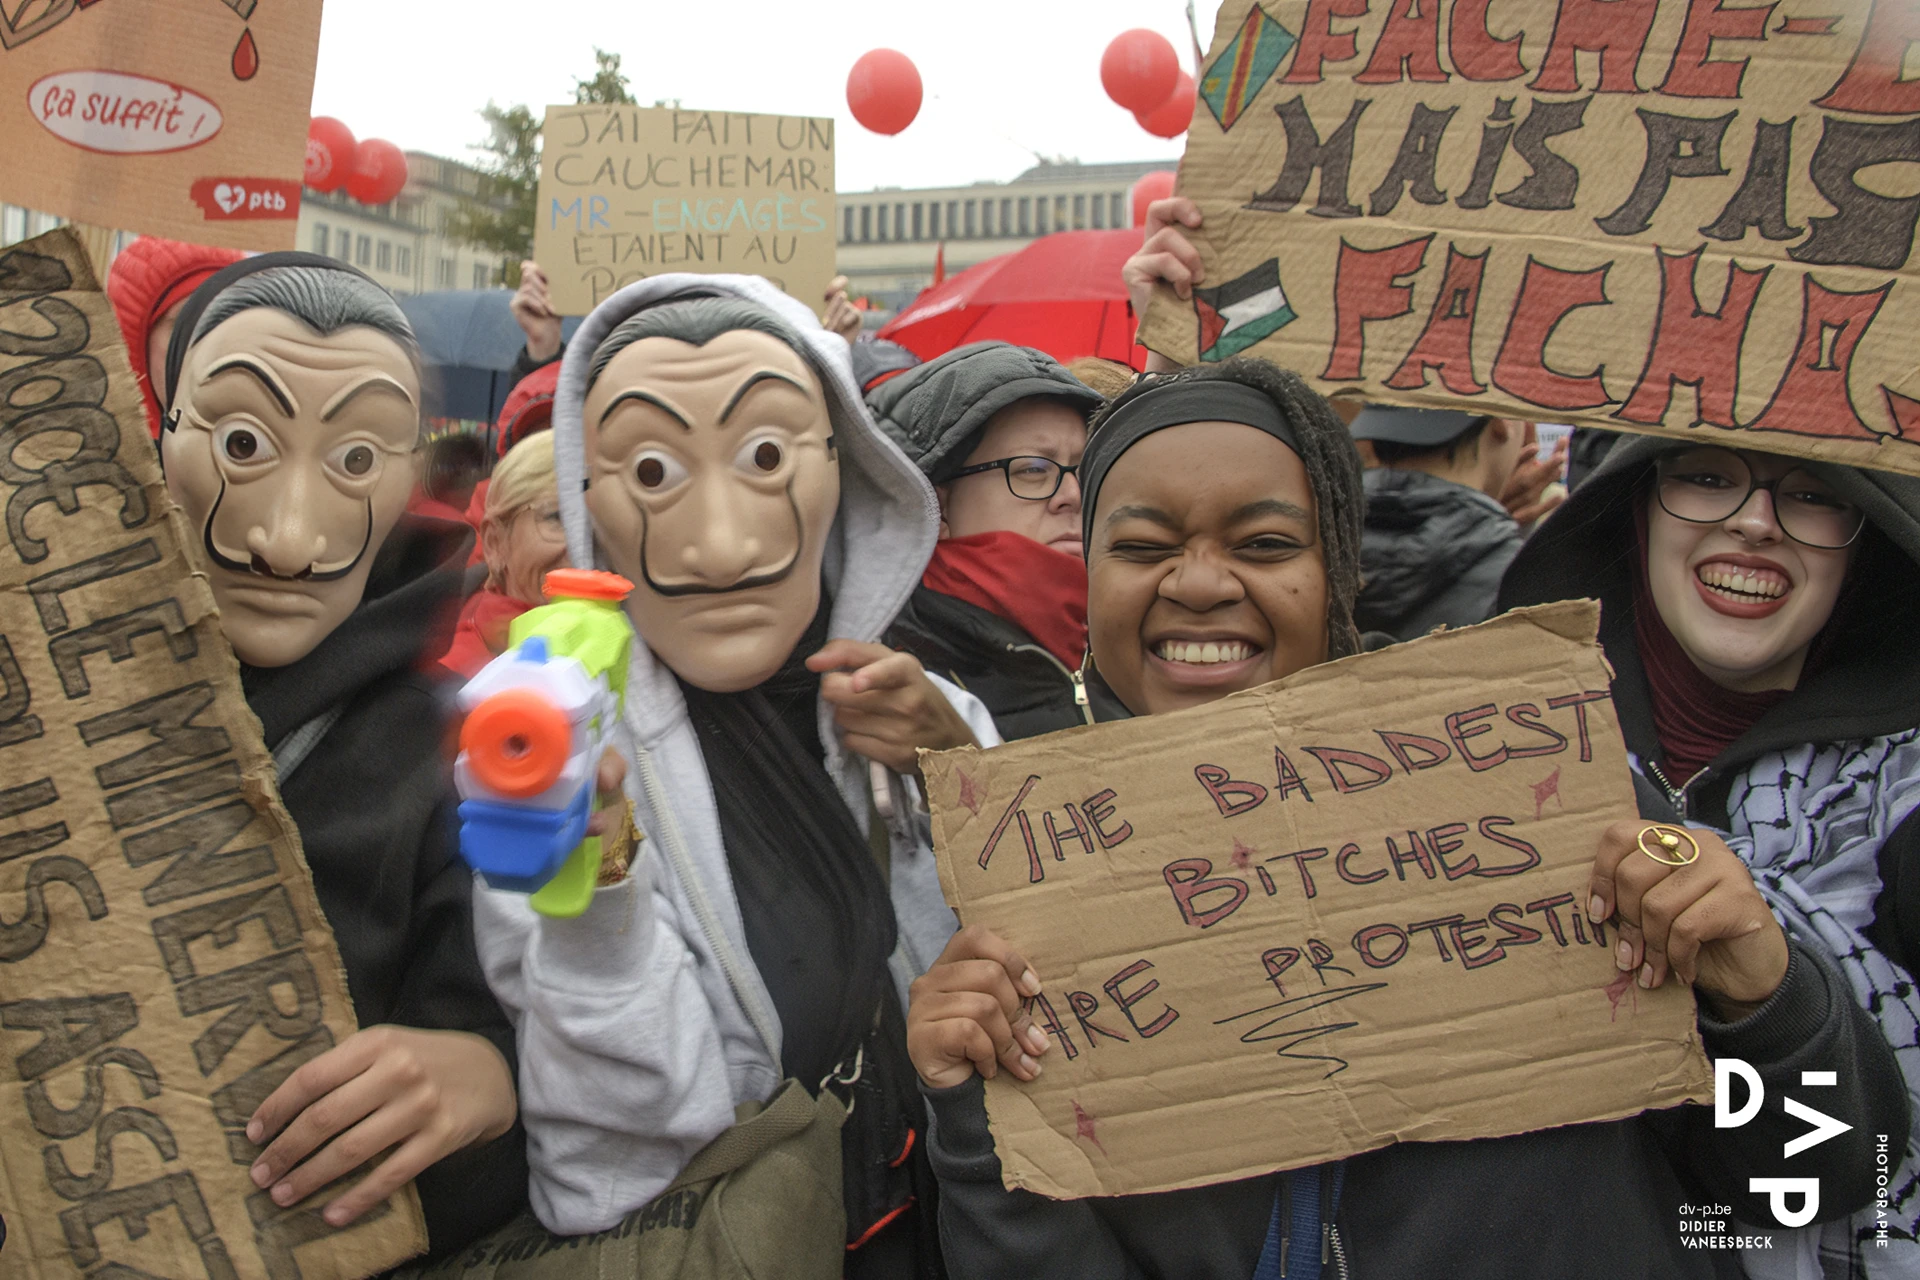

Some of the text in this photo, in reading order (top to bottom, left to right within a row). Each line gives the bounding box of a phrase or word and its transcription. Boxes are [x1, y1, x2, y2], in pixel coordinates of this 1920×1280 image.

[81, 92, 185, 134] suffit
[672, 110, 760, 146] FAIT
[776, 116, 832, 151] UN
[248, 189, 287, 212] ptb
[551, 194, 611, 231] MR
[1594, 106, 1920, 270] PAS
[742, 234, 798, 265] AU
[1316, 231, 1920, 446] FACHO
[27, 536, 199, 701] LE
[977, 689, 1613, 884] THE BADDEST
[1021, 957, 1181, 1062] ARE
